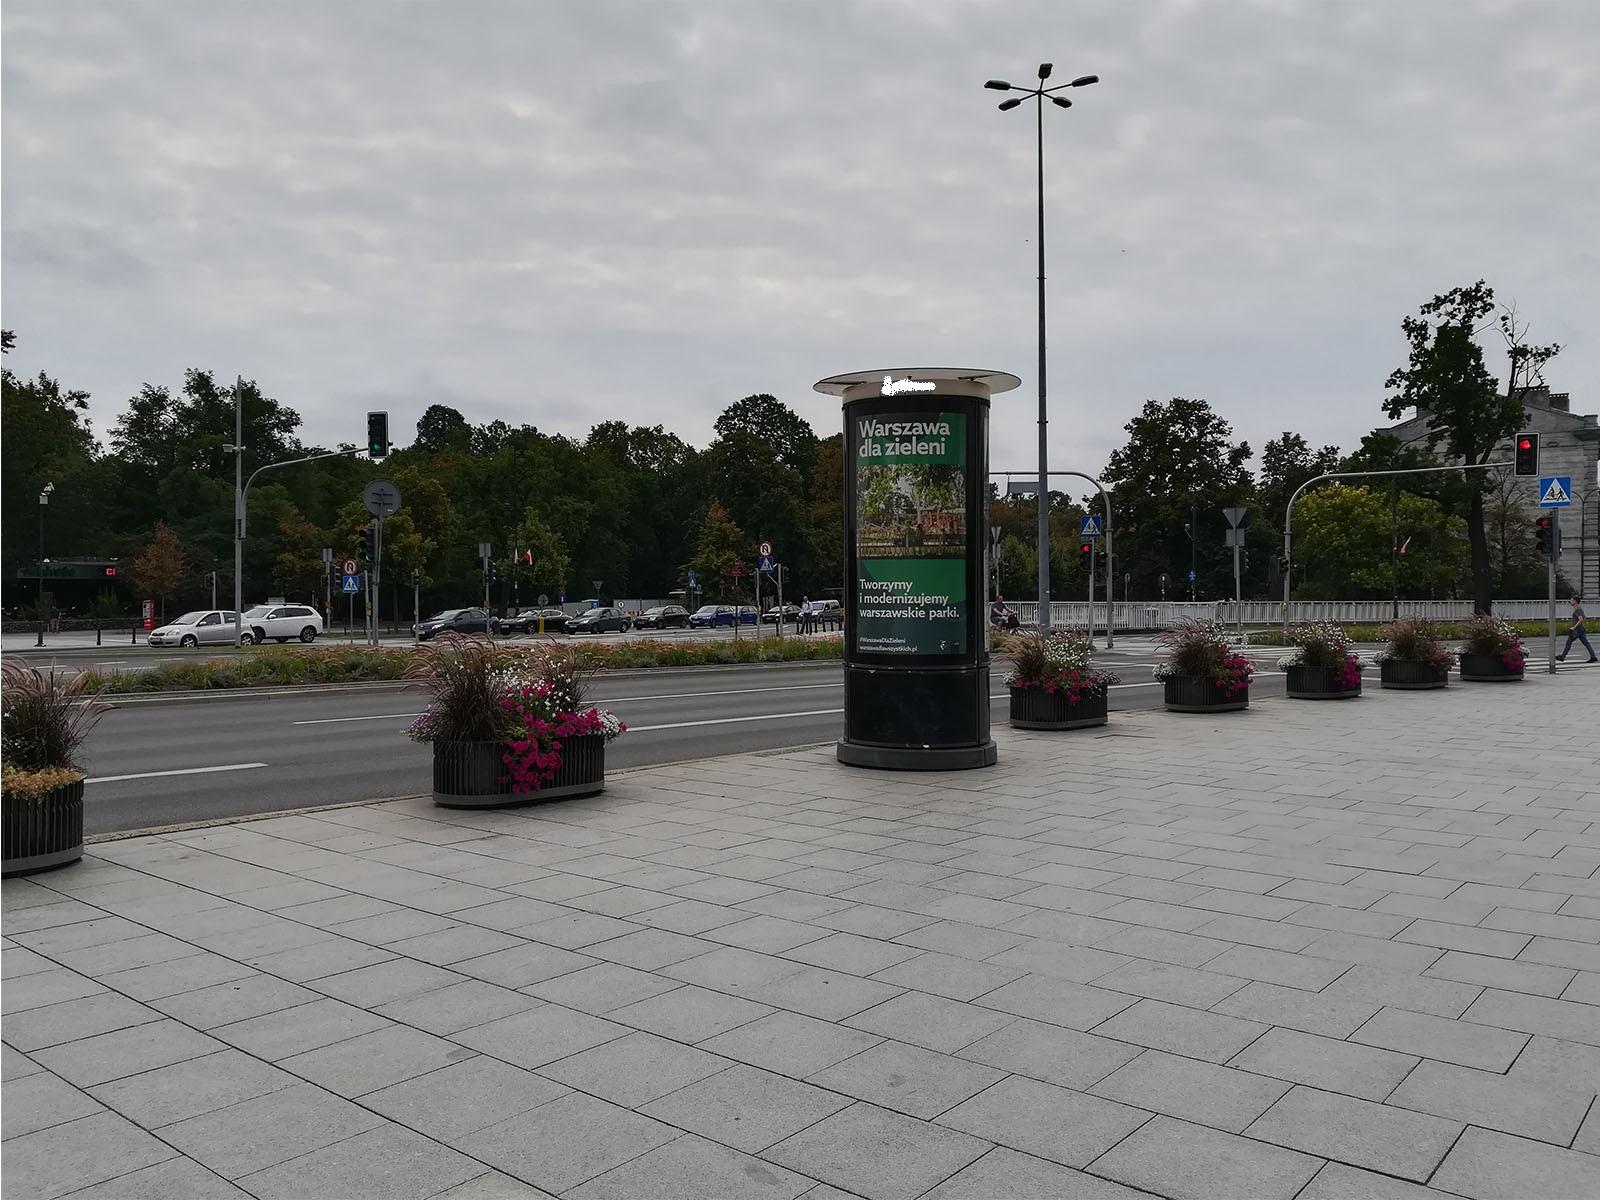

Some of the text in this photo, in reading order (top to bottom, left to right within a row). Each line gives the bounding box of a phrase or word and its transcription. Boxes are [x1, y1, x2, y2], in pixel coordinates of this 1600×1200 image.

[859, 419, 951, 438] Warszawa
[859, 436, 946, 458] dla zieleni
[859, 579, 913, 592] Tworzymy
[859, 592, 949, 606] i modernizujemy
[859, 606, 960, 620] warszawskie parki.
